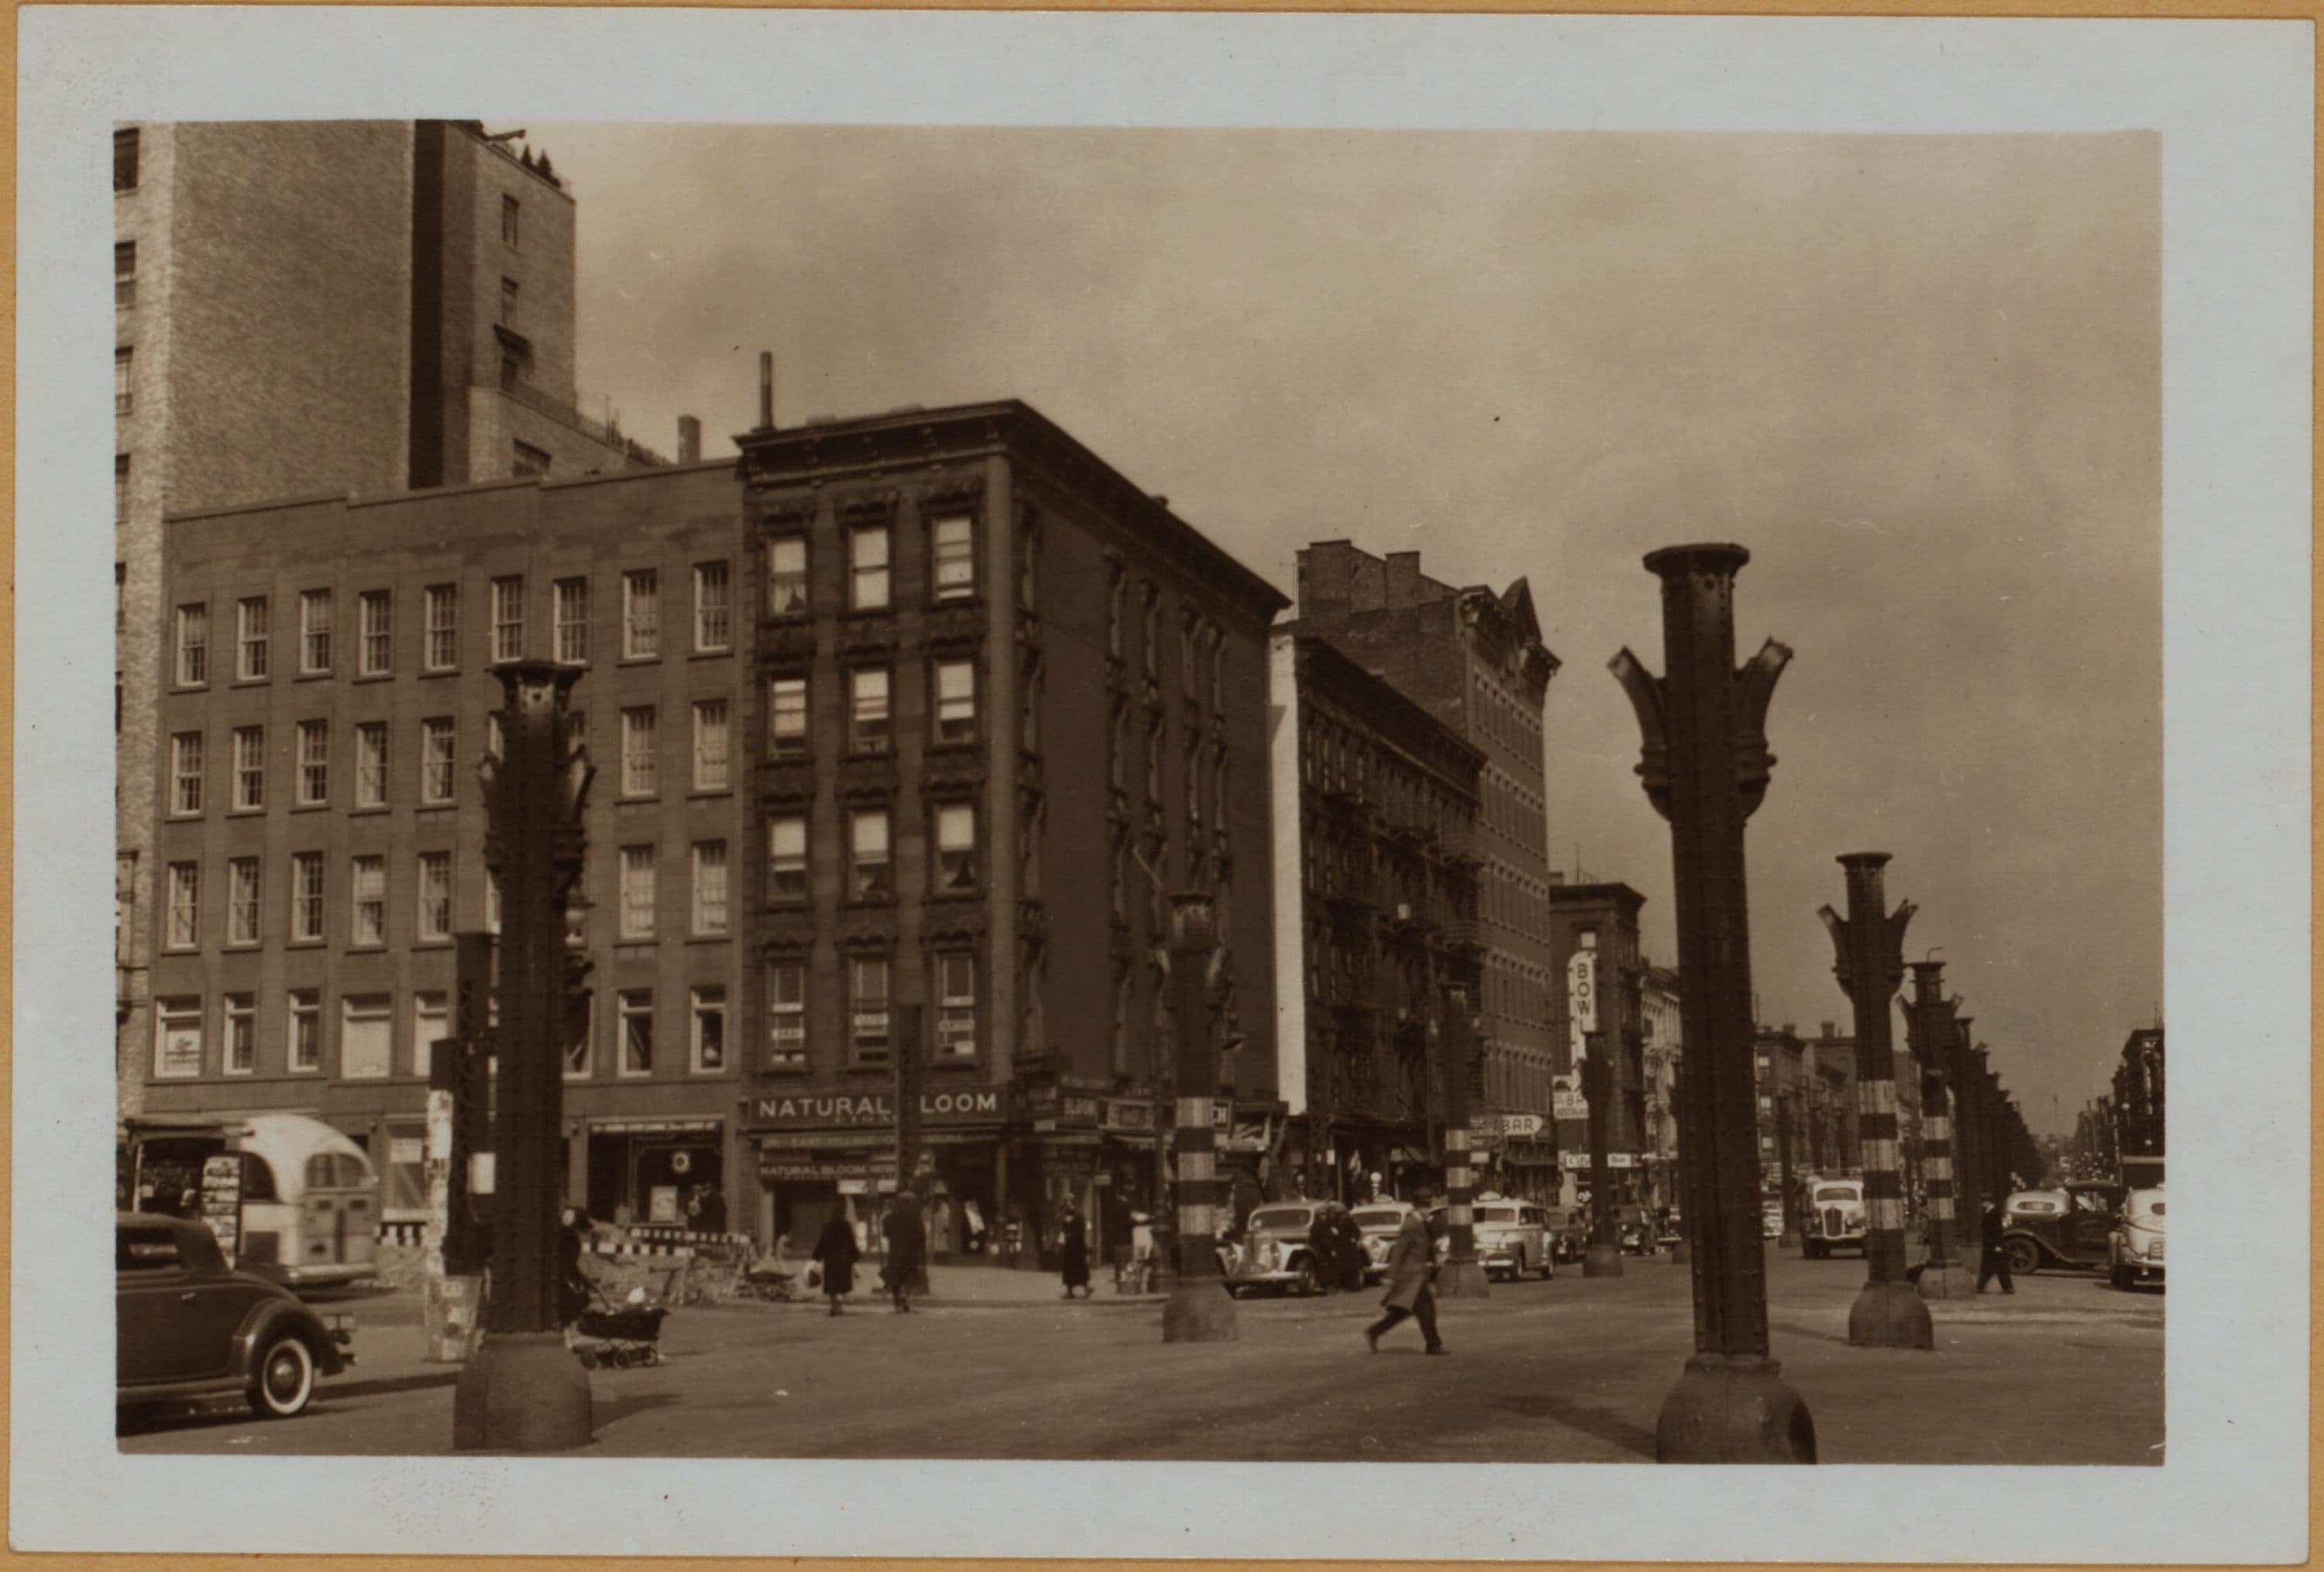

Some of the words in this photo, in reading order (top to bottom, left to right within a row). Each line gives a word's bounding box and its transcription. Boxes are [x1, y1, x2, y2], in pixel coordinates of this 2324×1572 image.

[759, 1096, 891, 1117] NATURAL
[920, 1092, 997, 1113] LOOM
[1501, 1117, 1534, 1133] BAR
[759, 1165, 819, 1176] NATURAL
[821, 1164, 865, 1174] BLOOM
